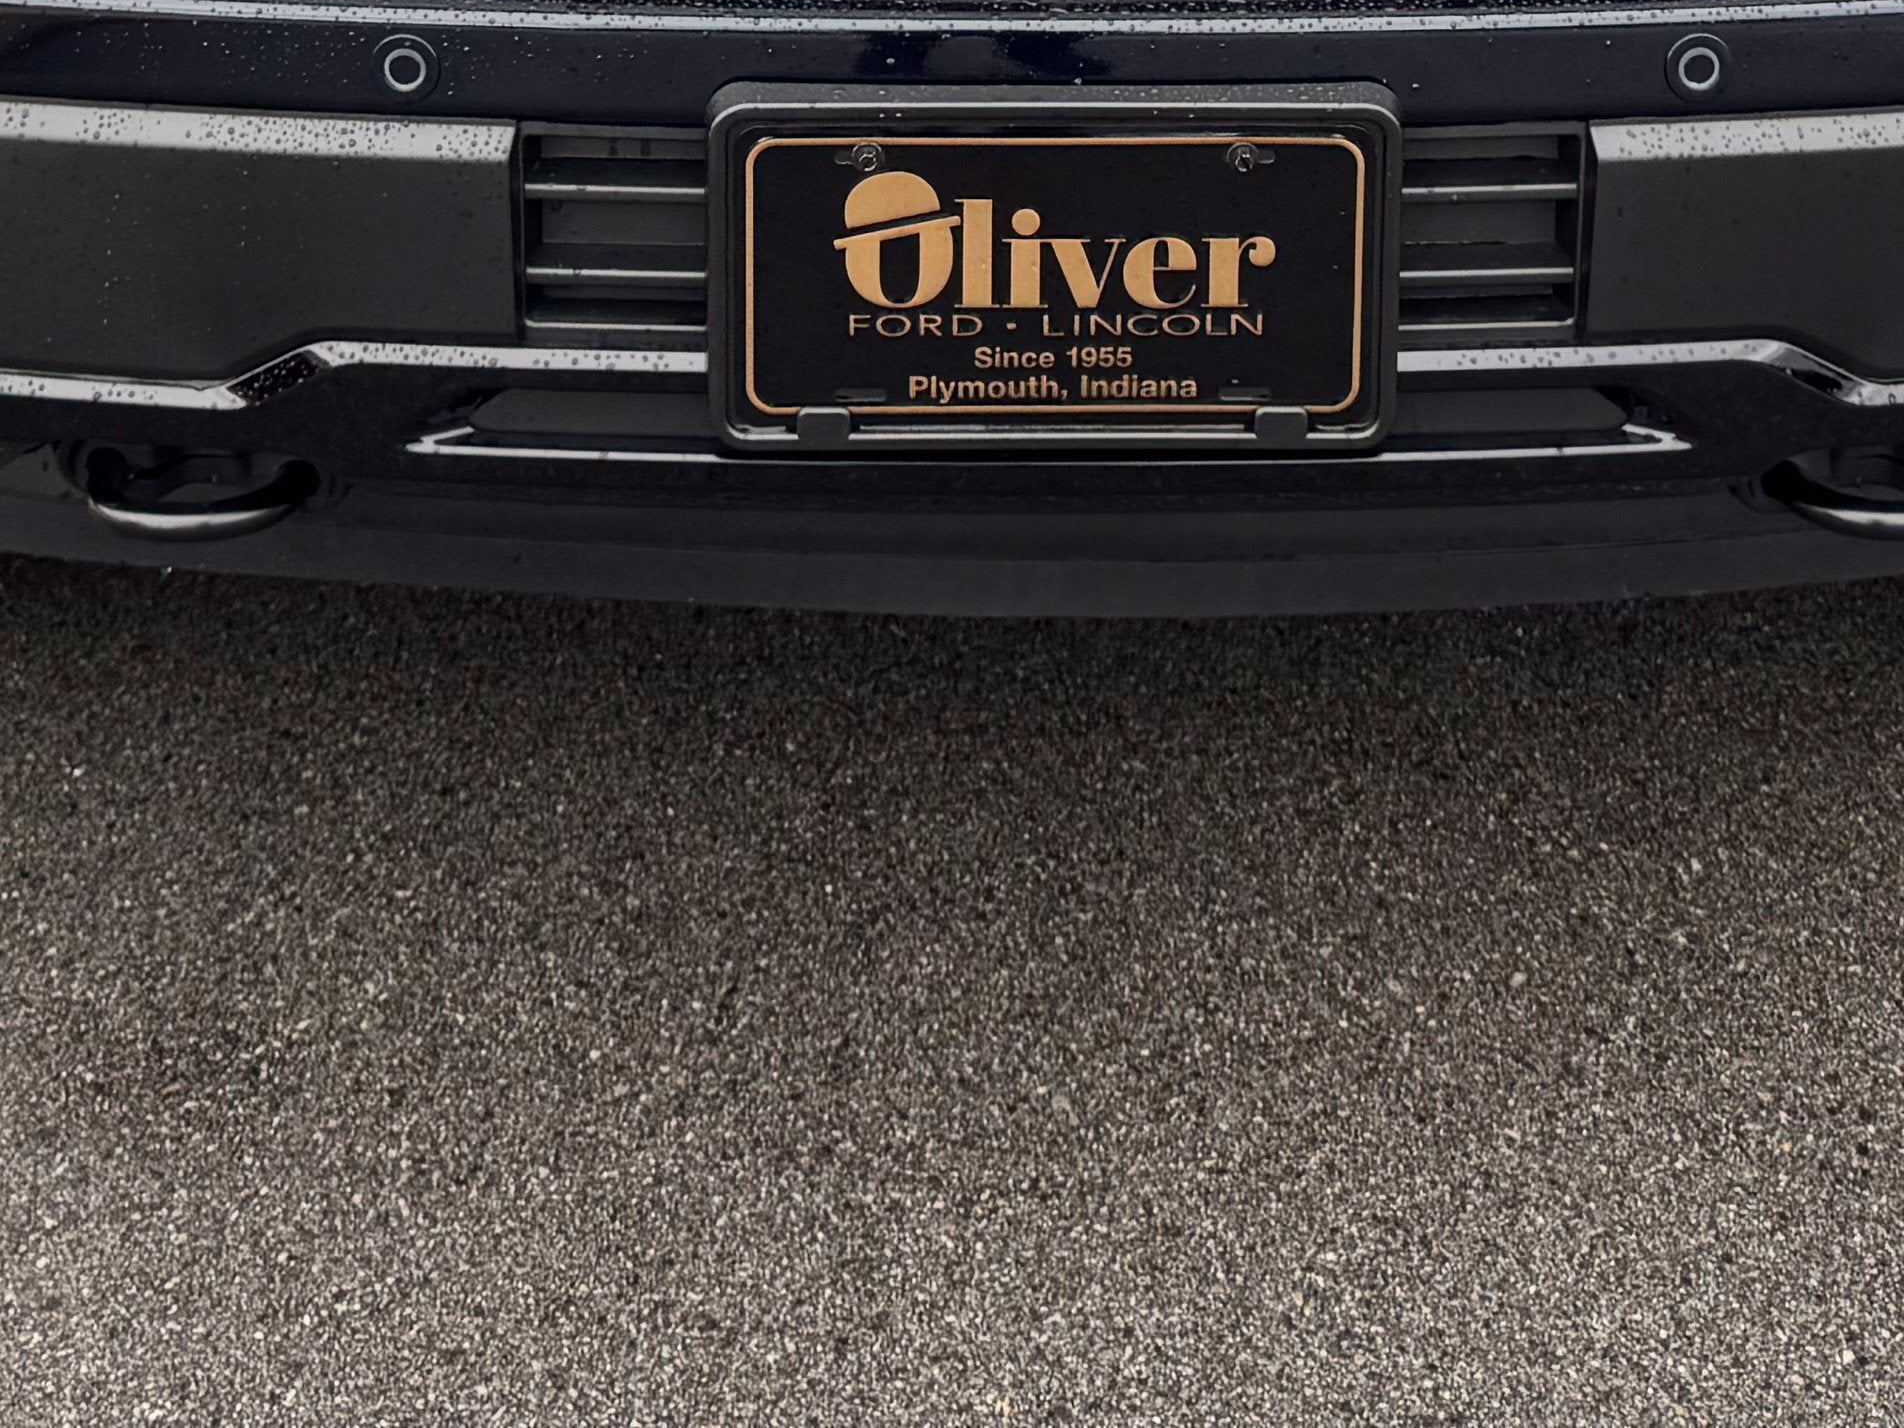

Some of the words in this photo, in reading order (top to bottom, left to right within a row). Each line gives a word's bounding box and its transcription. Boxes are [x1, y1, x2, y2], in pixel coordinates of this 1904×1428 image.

[833, 170, 1277, 310] Oliver
[848, 313, 983, 337] FORD
[1042, 313, 1264, 337] LINCOLN
[973, 346, 1056, 369] Since
[1066, 346, 1134, 369] 1955
[908, 375, 1069, 404] Plymouth,
[1080, 375, 1198, 400] Indiana
